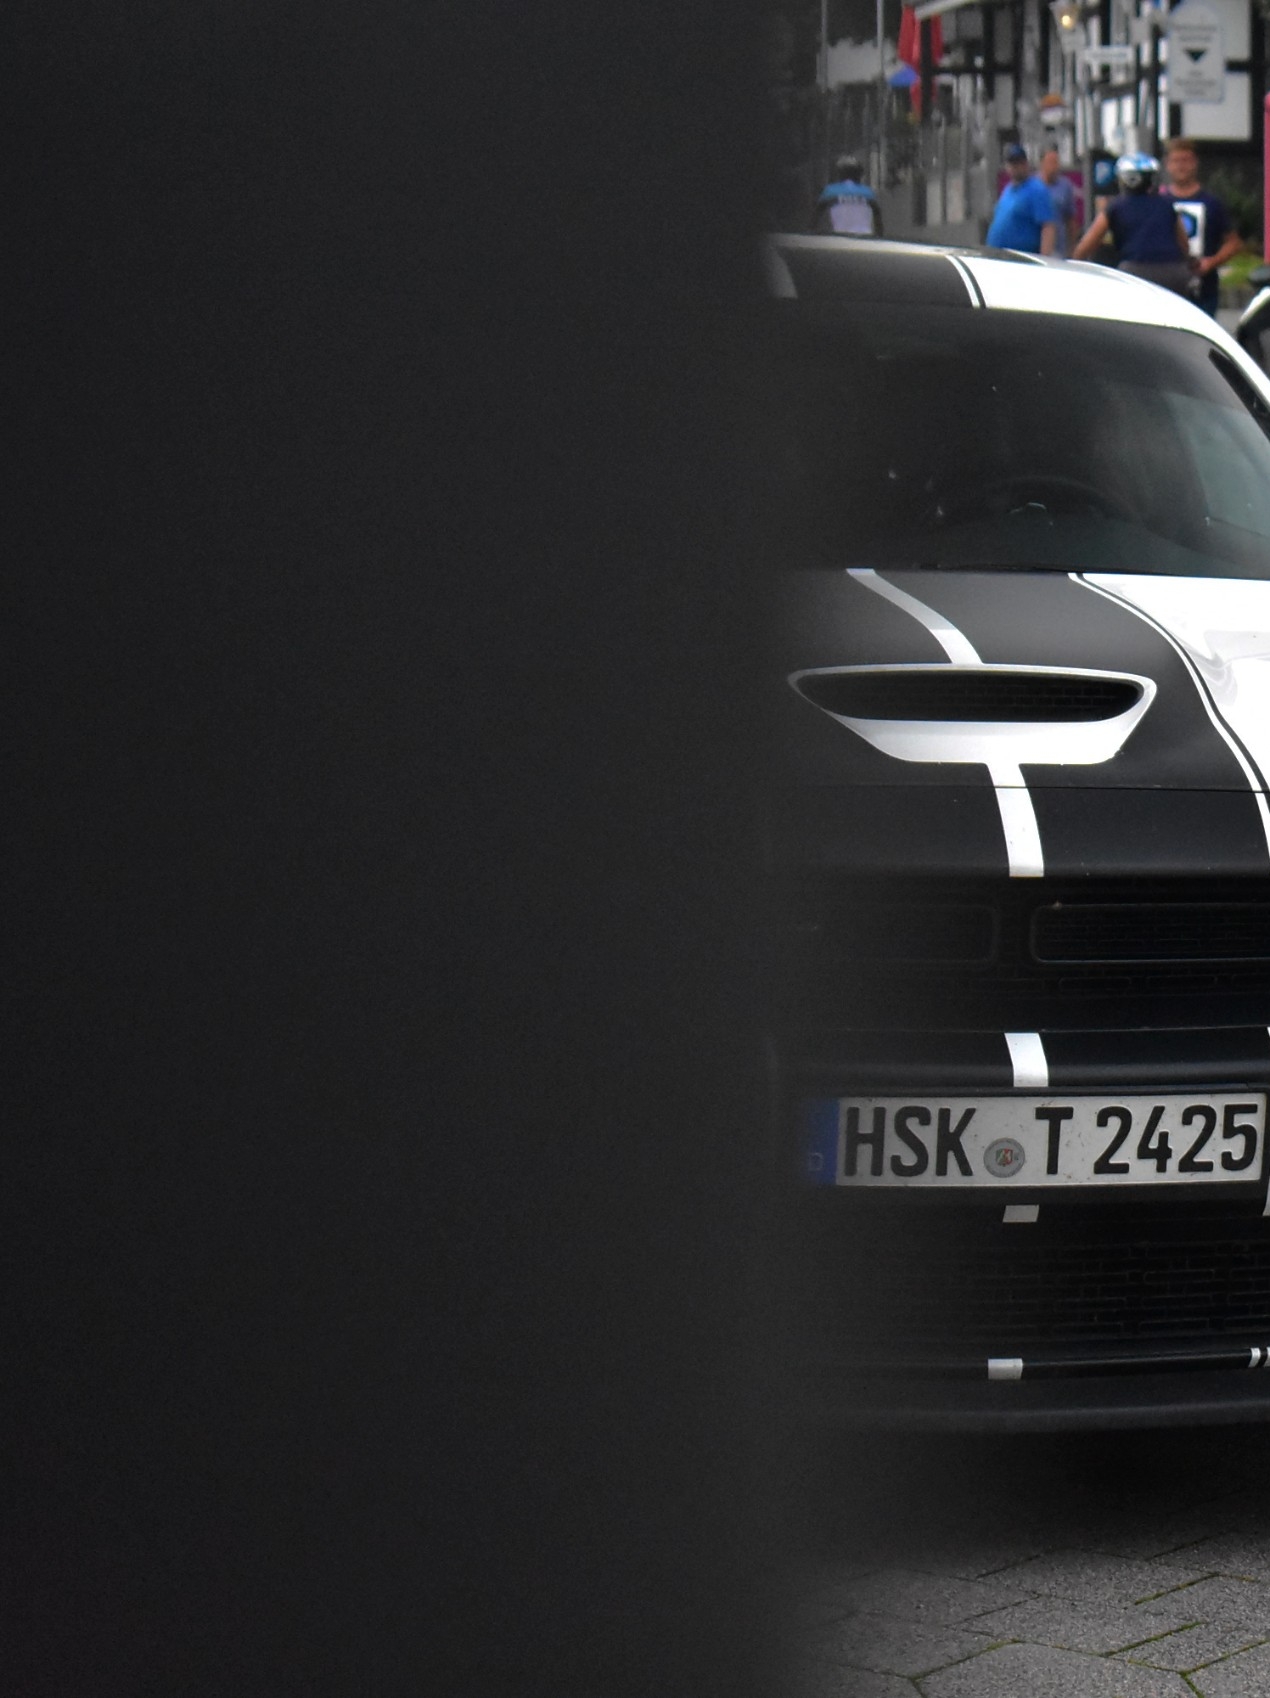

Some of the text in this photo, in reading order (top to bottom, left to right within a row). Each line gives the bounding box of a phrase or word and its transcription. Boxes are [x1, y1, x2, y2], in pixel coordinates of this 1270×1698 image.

[843, 1106, 977, 1178] HSK
[1035, 1106, 1074, 1176] T
[1093, 1103, 1259, 1175] 2425
